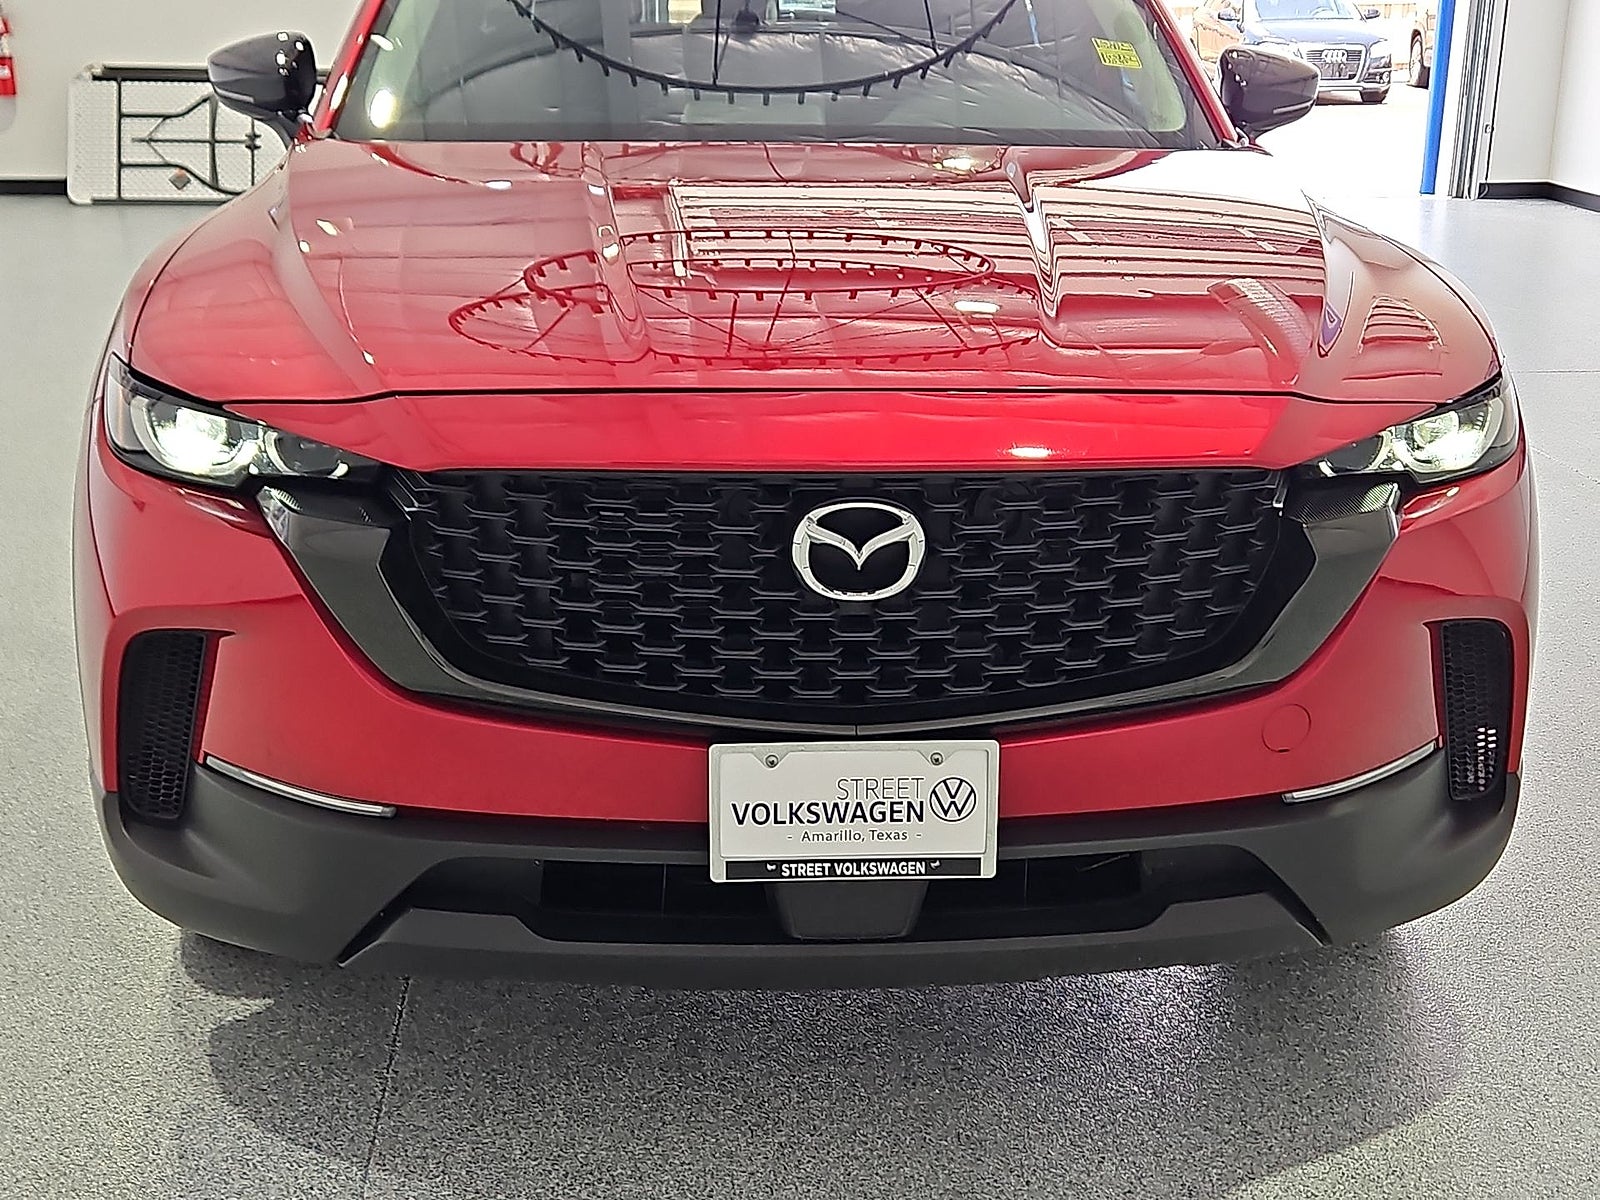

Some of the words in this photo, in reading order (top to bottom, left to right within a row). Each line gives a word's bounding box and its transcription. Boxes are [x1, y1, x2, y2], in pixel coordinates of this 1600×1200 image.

[836, 777, 925, 801] STREET
[731, 801, 925, 826] VOLKSWAGEN
[801, 830, 865, 842] Amarillo,
[869, 829, 908, 841] Texas
[781, 863, 830, 877] STREET
[834, 861, 926, 876] VOLKSWAGEN
